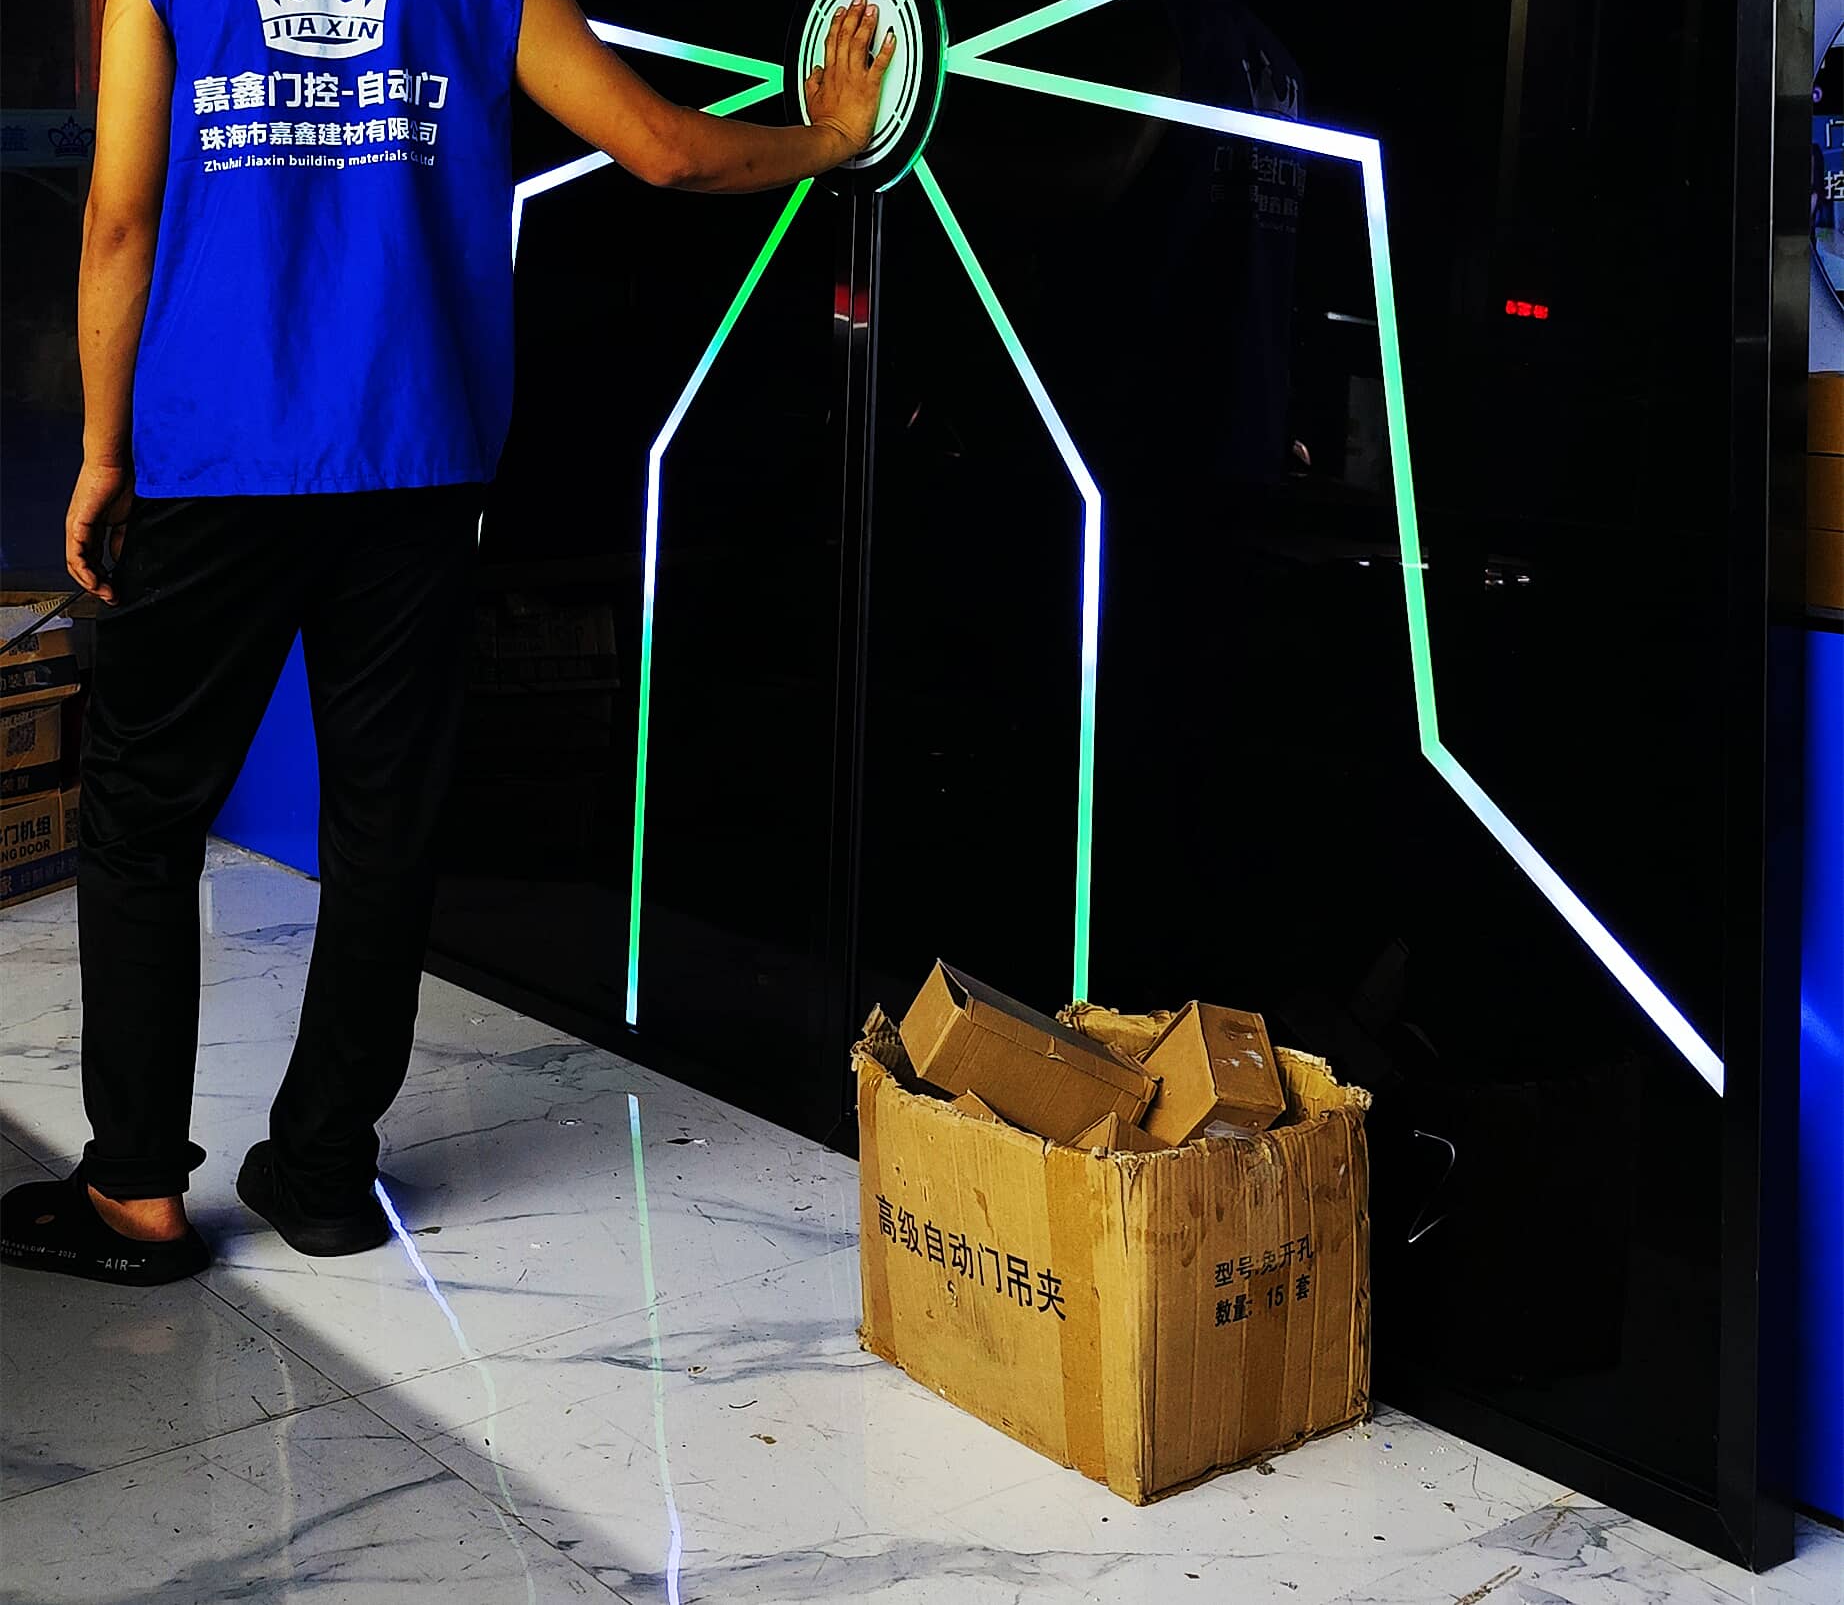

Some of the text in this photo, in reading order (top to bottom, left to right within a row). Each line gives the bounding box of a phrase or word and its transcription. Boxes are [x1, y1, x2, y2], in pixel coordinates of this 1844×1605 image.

[200, 117, 438, 151] 珠海市嘉鑫建材有限公司
[245, 154, 285, 167] Jiaxin
[288, 155, 345, 170] building
[348, 149, 408, 167] materials
[0, 815, 51, 847] 门机组
[20, 839, 50, 857] DOOR
[876, 1194, 1066, 1321] 高级自动门吊夹
[1267, 1284, 1284, 1309] 15
[1295, 1274, 1310, 1301] 套
